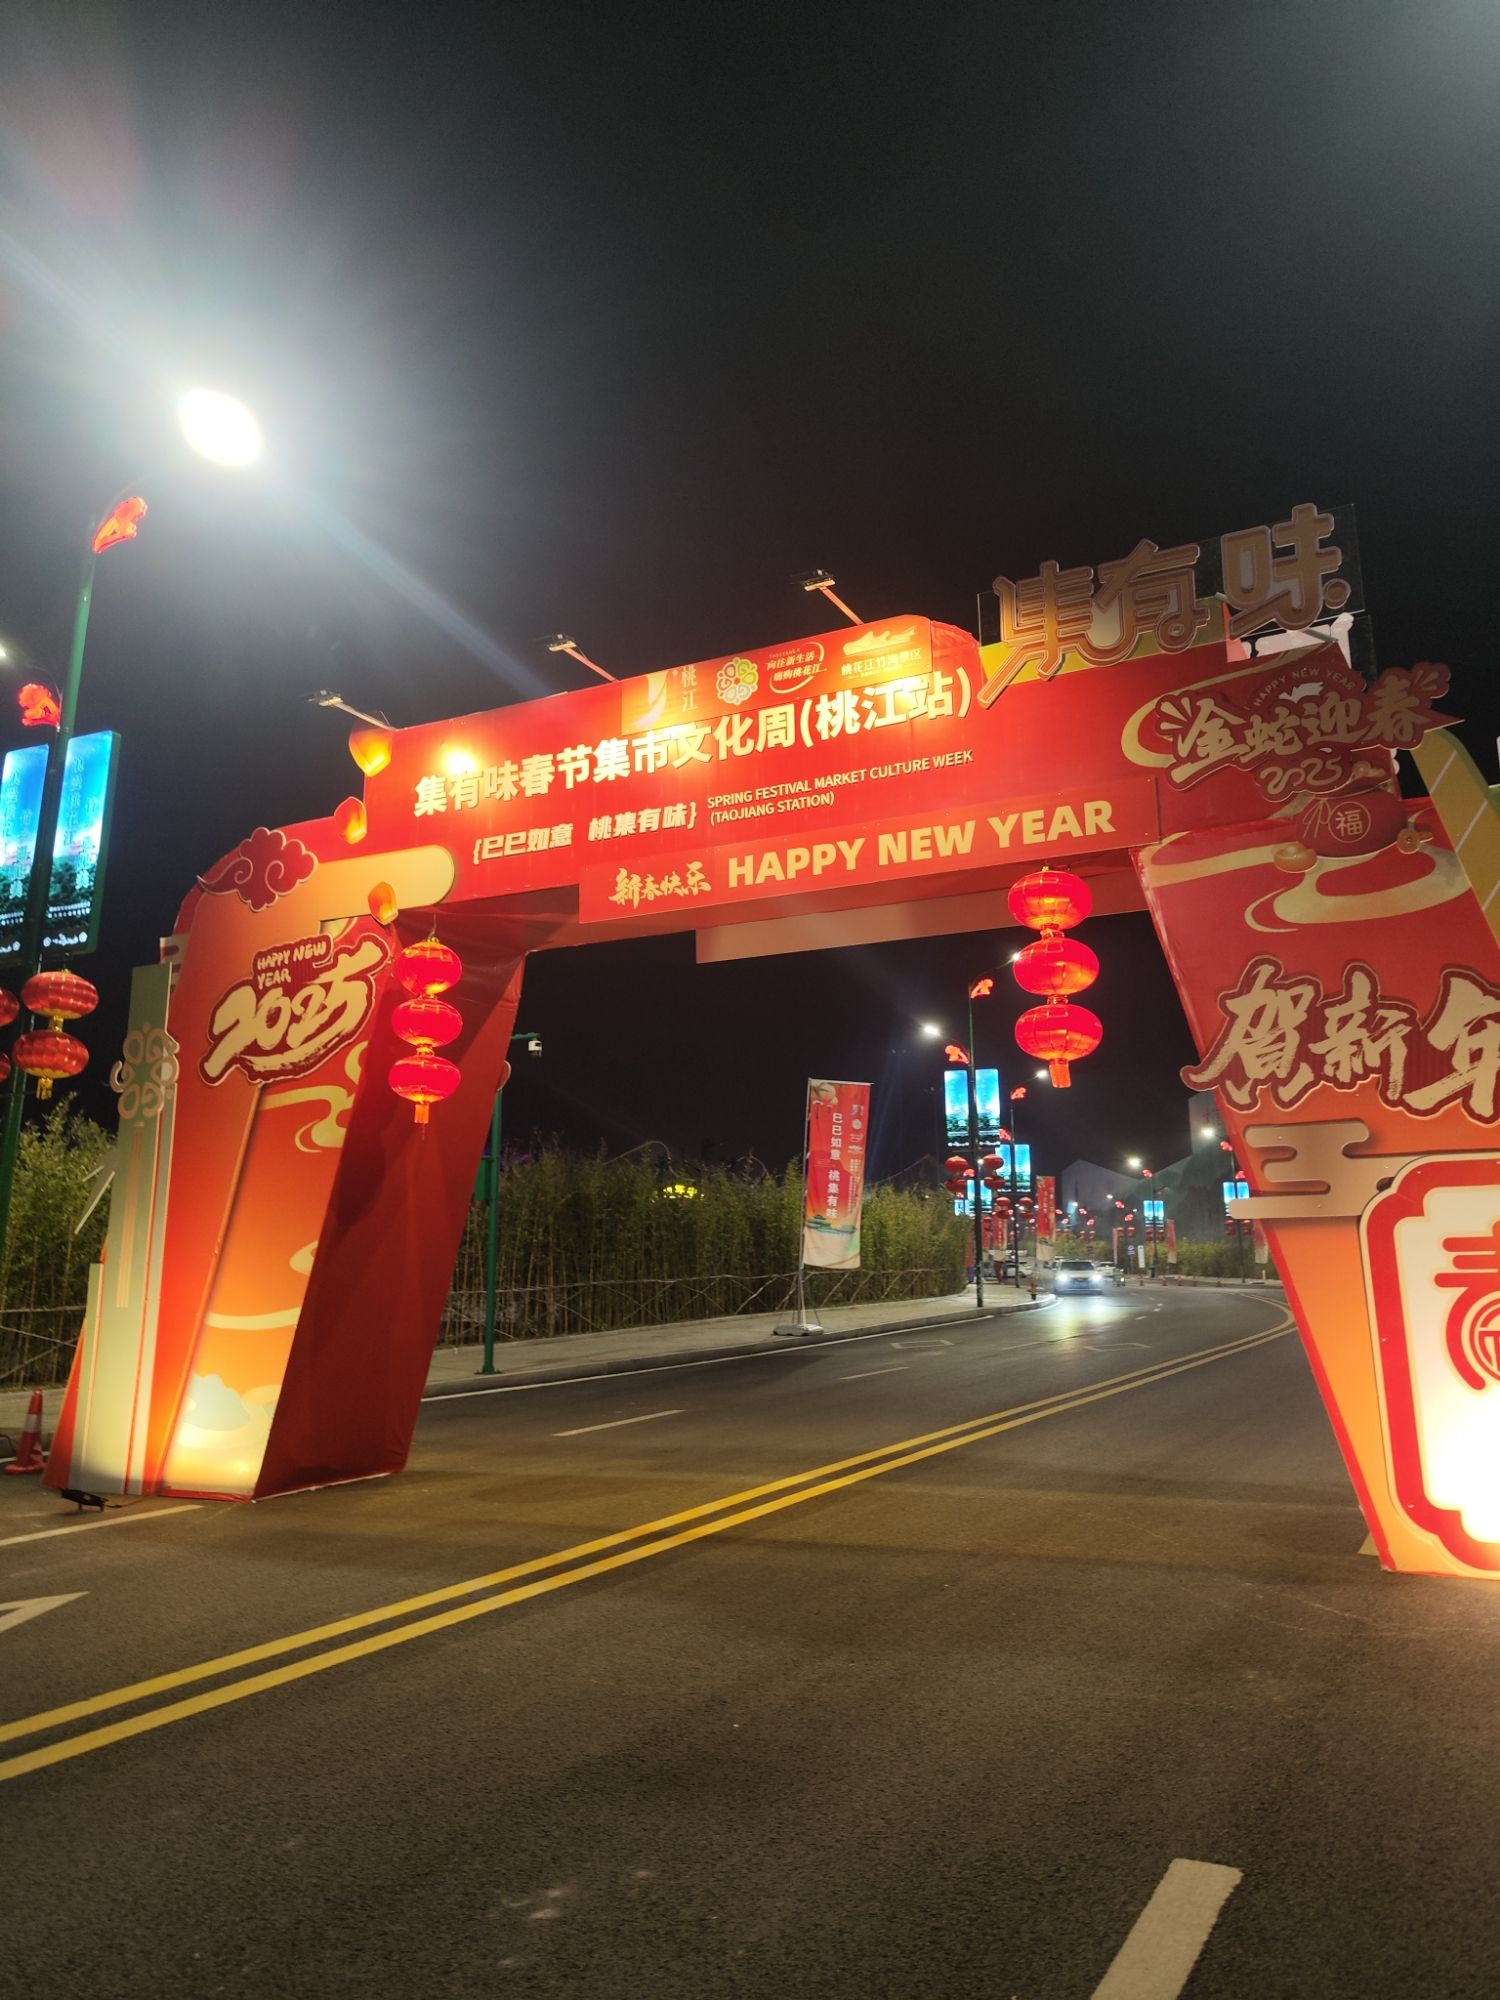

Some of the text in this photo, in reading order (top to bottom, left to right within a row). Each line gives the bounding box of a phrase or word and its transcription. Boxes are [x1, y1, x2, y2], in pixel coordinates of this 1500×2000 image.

[681, 664, 698, 712] 桃江
[1254, 668, 1356, 706] HAPPY NEW YEAR
[1170, 674, 1431, 783] 金蛇迎春
[707, 749, 973, 808] SPRING FESTIVAL MARKET CULTURE WEEK
[1260, 754, 1342, 795] 2025
[710, 791, 835, 827] (TAOJIANG STATION)
[1335, 809, 1363, 836] 福
[728, 800, 1117, 888] HAPPY NEW YEAR
[609, 861, 711, 909] 新春快乐
[257, 941, 326, 970] HAPPY NEW
[258, 968, 291, 989] YEAR
[204, 941, 384, 1078] 2025
